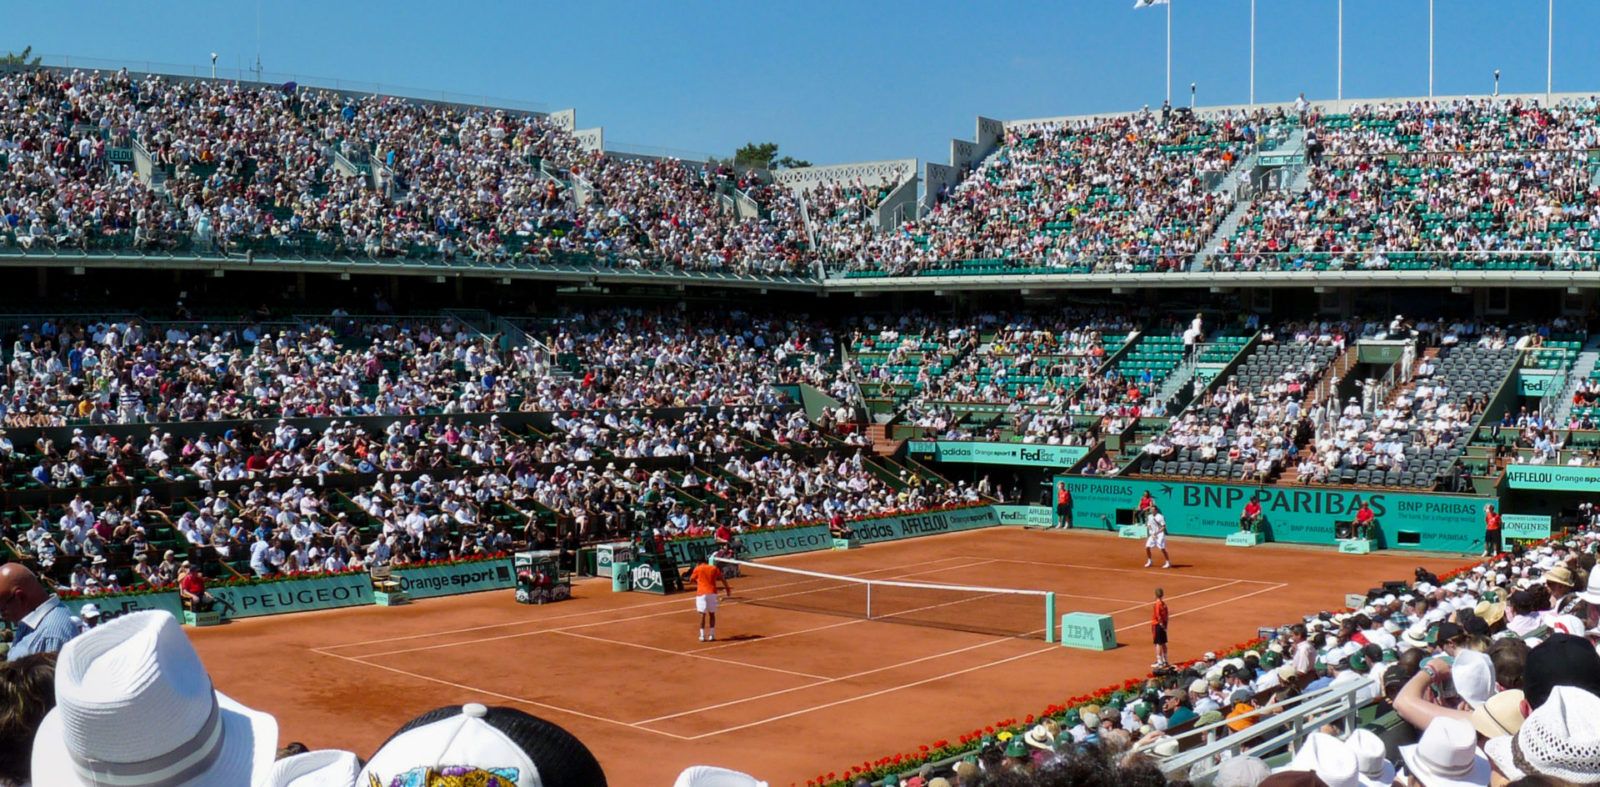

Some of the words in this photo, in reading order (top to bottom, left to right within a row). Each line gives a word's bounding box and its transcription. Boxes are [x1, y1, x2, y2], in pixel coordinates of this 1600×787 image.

[942, 448, 971, 456] adidas
[1021, 448, 1054, 462] FedEx
[1508, 472, 1552, 483] AFFLELOU
[1555, 475, 1584, 483] Orange
[1067, 483, 1088, 493] BNP
[1091, 484, 1133, 496] PARIBAS
[1184, 486, 1244, 509] BNP
[1256, 489, 1387, 518] PARIBAS
[1398, 501, 1423, 511] BNP
[1426, 503, 1476, 515] PARIBAS
[1001, 511, 1026, 520] FedEx
[902, 514, 948, 536] AFFLELOU
[1502, 522, 1549, 531] LONGINES
[753, 534, 827, 553] PEUGEOT
[401, 573, 449, 591] Orange
[451, 568, 495, 586] sport
[243, 585, 364, 610] PEUGEOT
[1067, 624, 1095, 640] IBM
